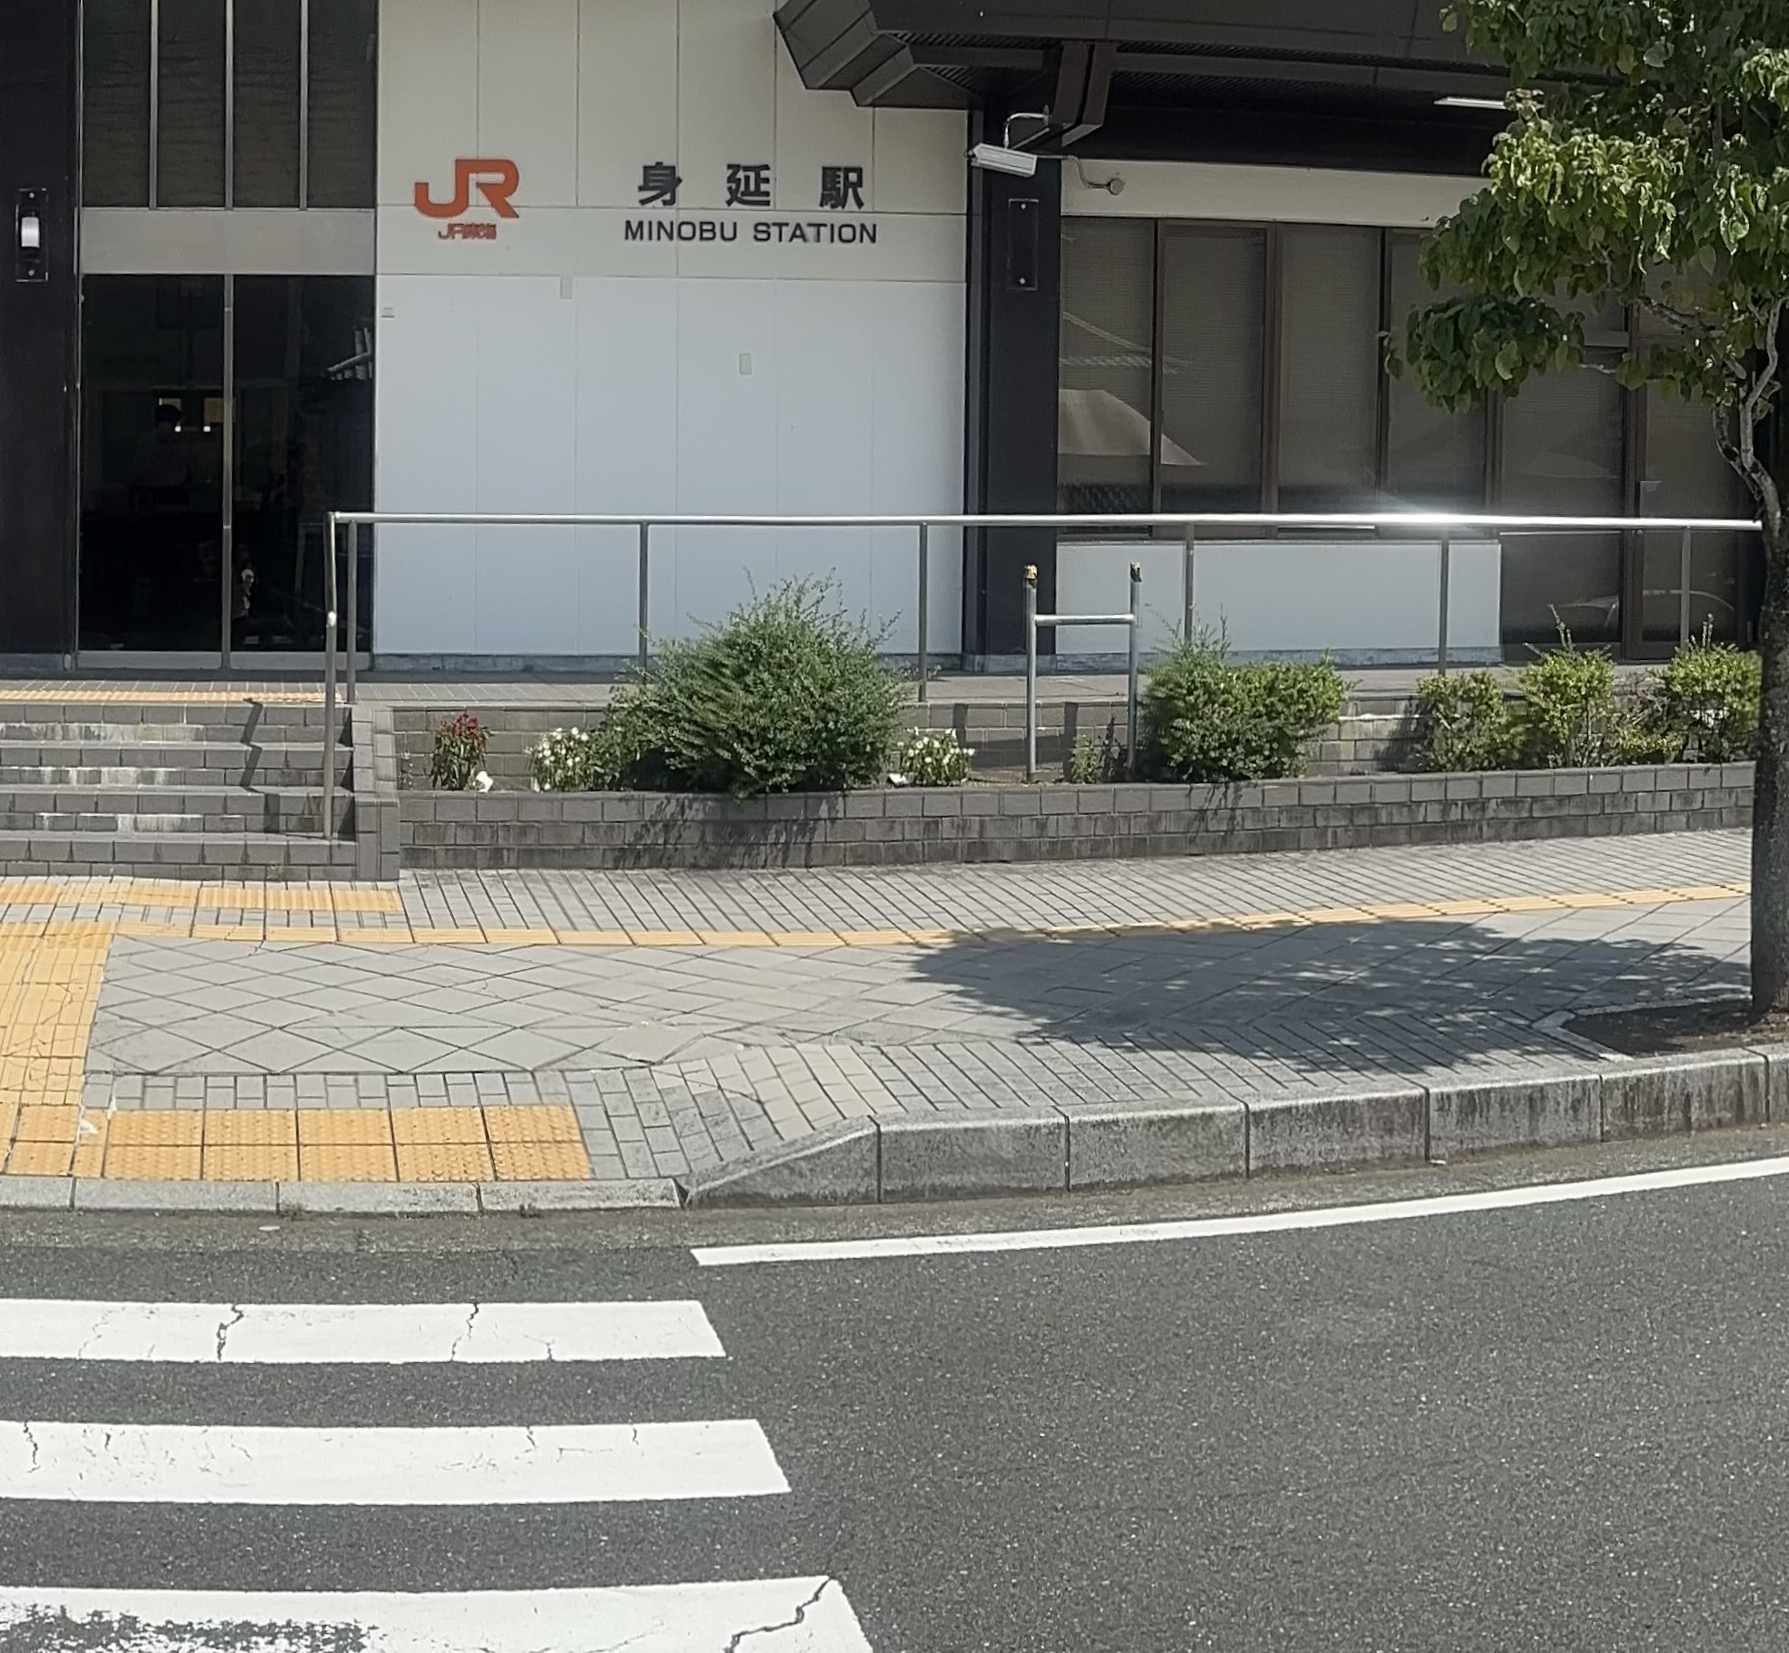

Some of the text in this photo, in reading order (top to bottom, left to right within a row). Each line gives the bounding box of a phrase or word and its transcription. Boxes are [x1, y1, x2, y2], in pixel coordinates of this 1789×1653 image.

[414, 159, 519, 218] JR
[638, 162, 864, 210] 身延駅
[625, 220, 877, 244] MINOBU STATION
